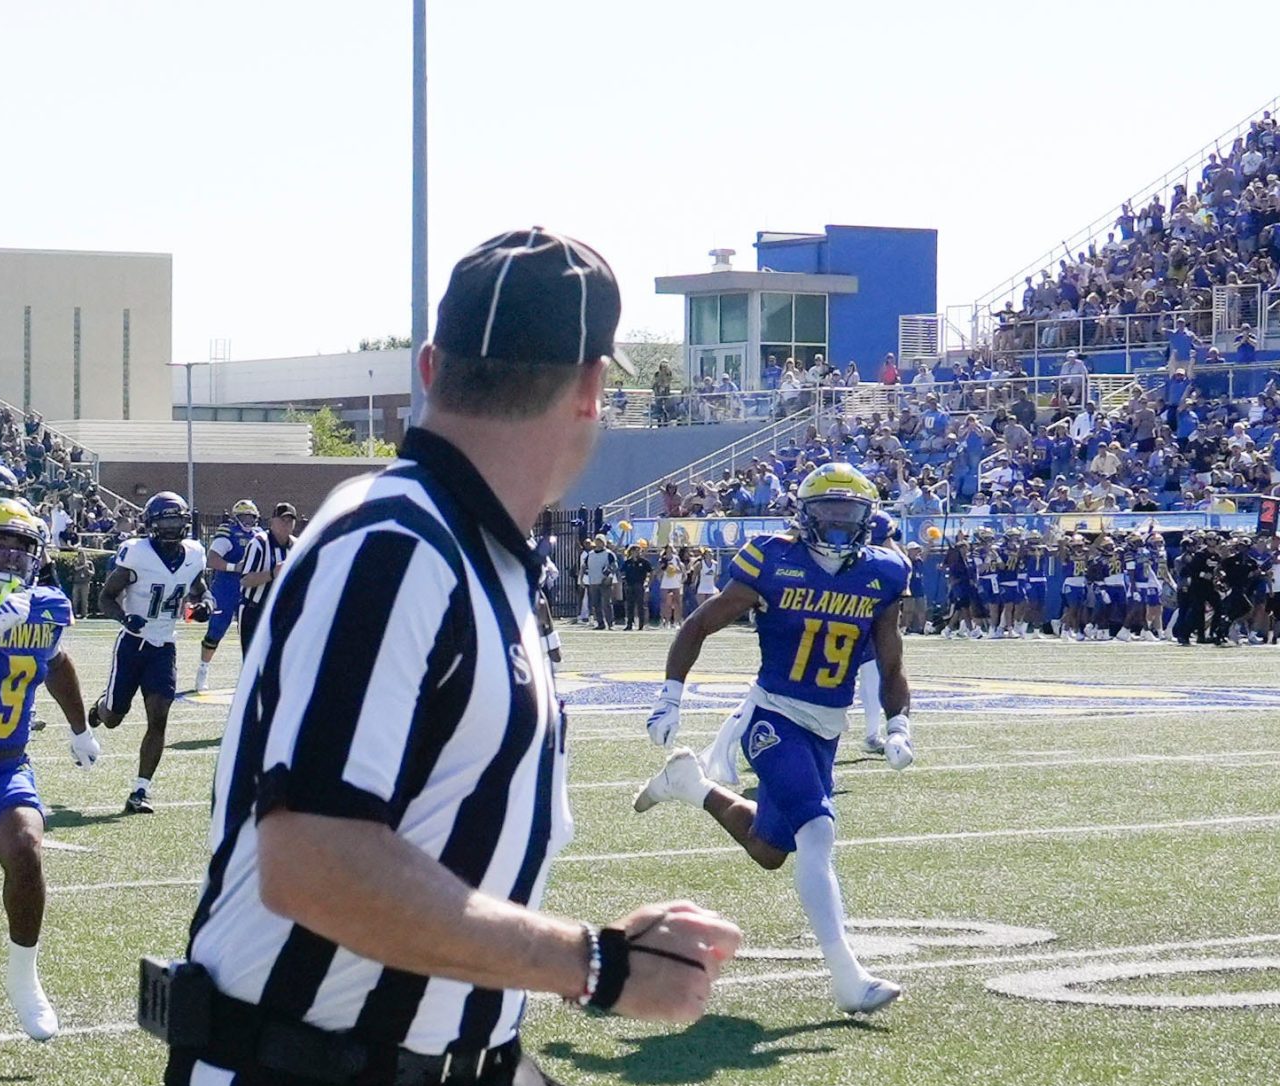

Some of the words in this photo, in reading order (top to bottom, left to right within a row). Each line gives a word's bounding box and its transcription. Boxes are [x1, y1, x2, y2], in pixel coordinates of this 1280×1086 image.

[1261, 501, 1276, 523] 2
[146, 583, 187, 620] 14
[778, 587, 882, 619] DELAWARE
[508, 642, 532, 686] S
[788, 617, 861, 689] 19
